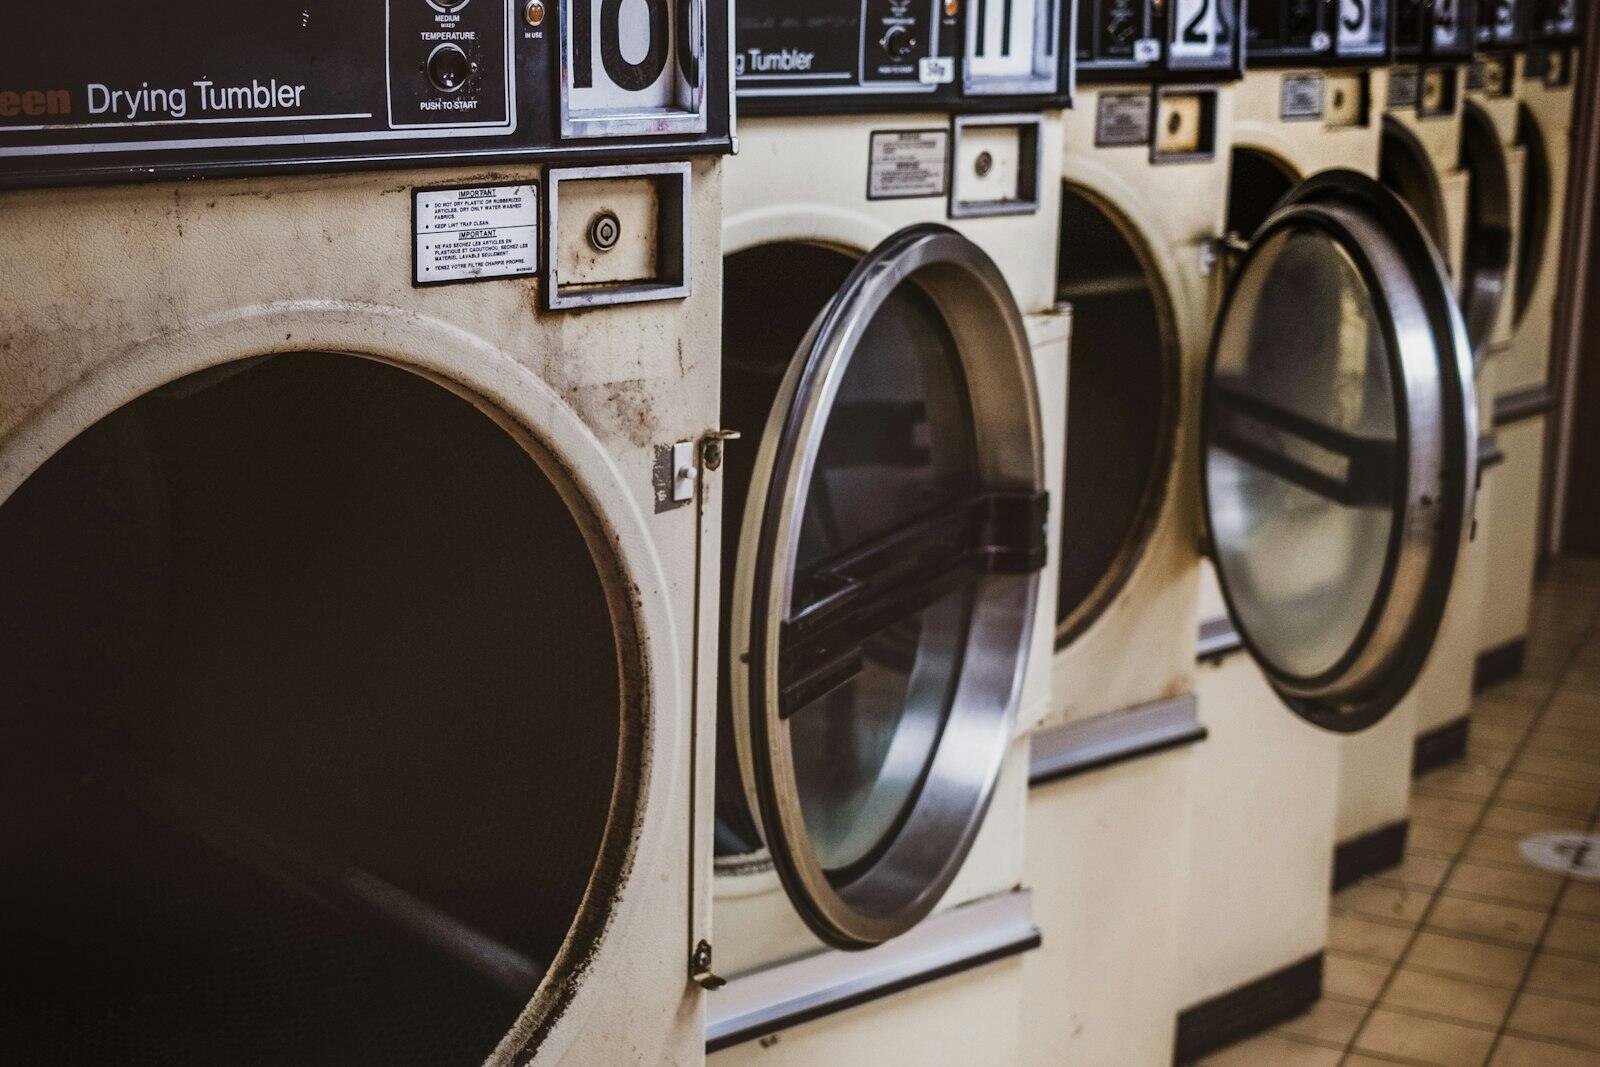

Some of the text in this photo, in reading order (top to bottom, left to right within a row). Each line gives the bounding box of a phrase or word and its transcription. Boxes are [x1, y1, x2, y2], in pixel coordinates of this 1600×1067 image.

[434, 14, 461, 22] MEDIUM
[420, 31, 476, 41] TEMPERATURE
[532, 31, 543, 39] USE
[572, 0, 670, 91] 10
[748, 49, 814, 71] Tumbler
[0, 79, 306, 118] een Drying Tumbler
[420, 100, 478, 110] PUSH TO START
[458, 190, 497, 198] IMPORTANT
[458, 230, 497, 239] IMPORTANT
